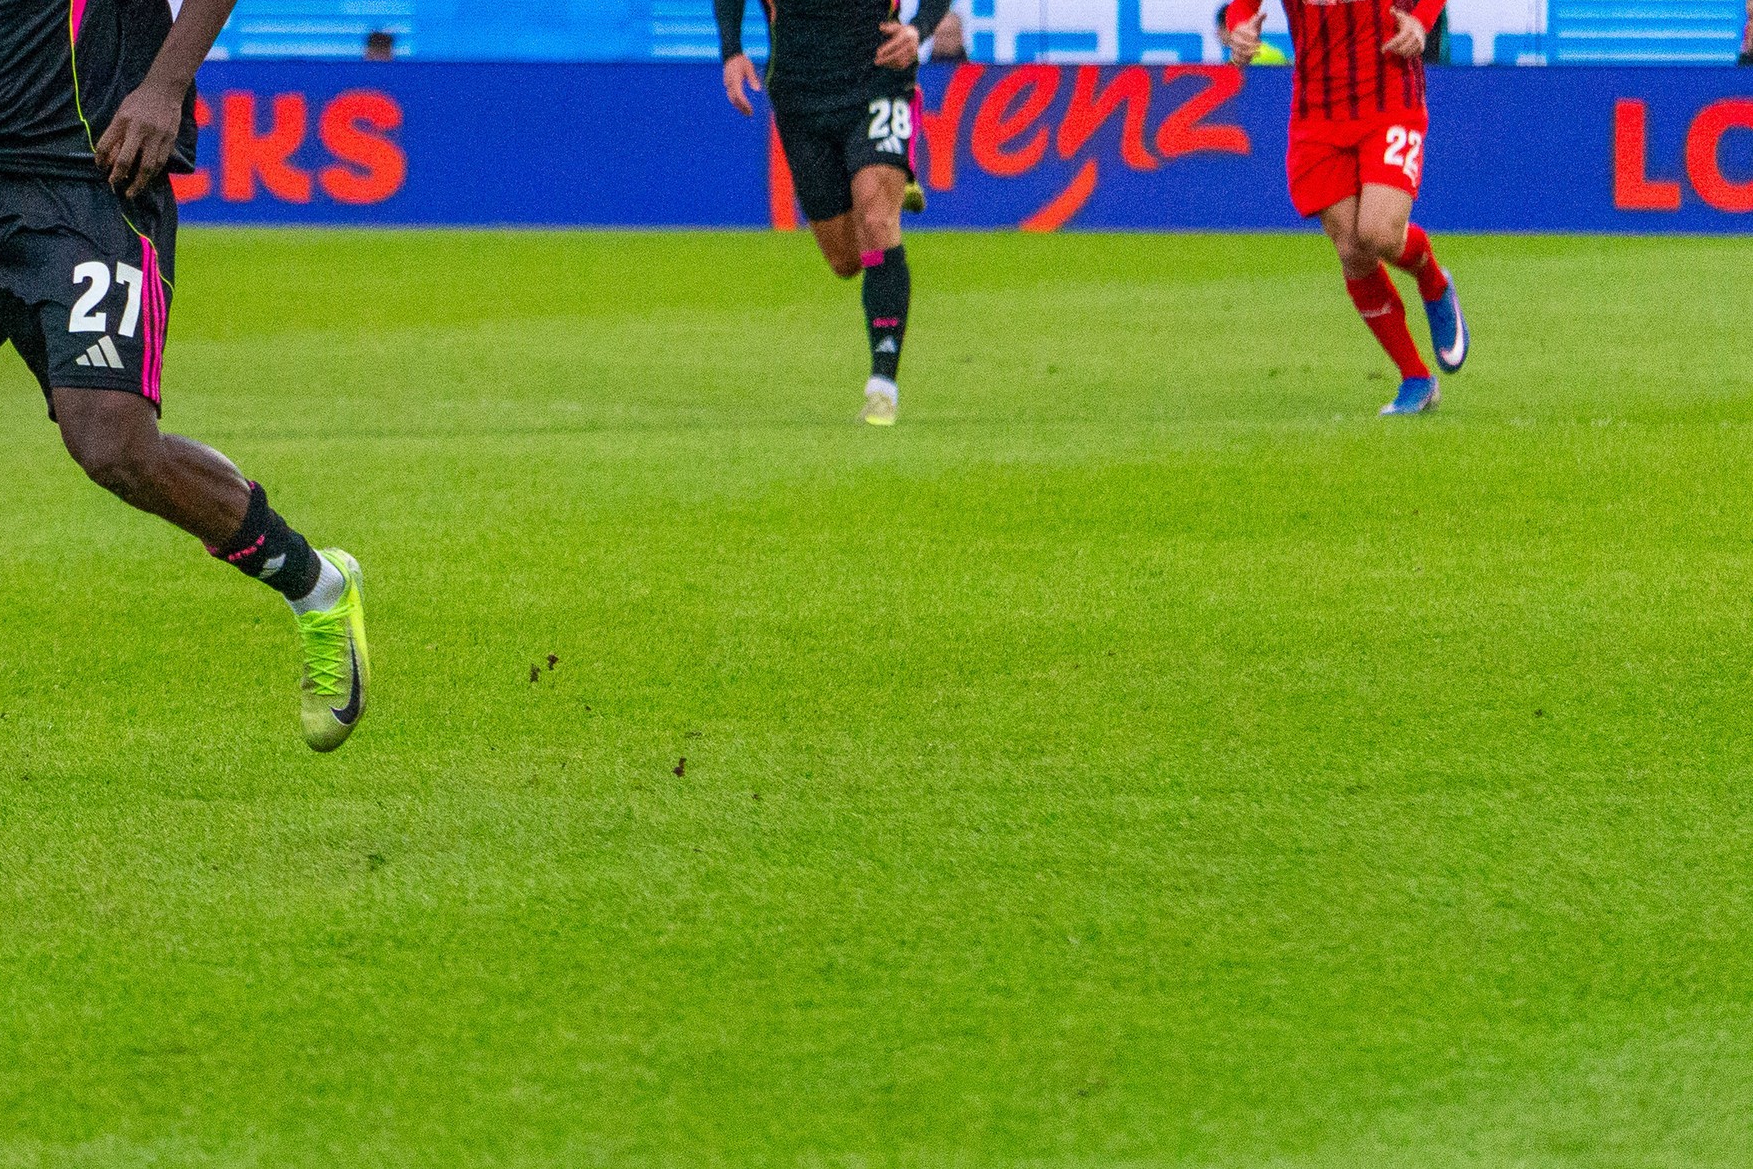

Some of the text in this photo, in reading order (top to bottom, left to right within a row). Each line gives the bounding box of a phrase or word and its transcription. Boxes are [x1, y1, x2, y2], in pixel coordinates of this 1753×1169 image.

[867, 98, 912, 141] 28
[1384, 125, 1422, 187] 22
[69, 261, 143, 338] 27
